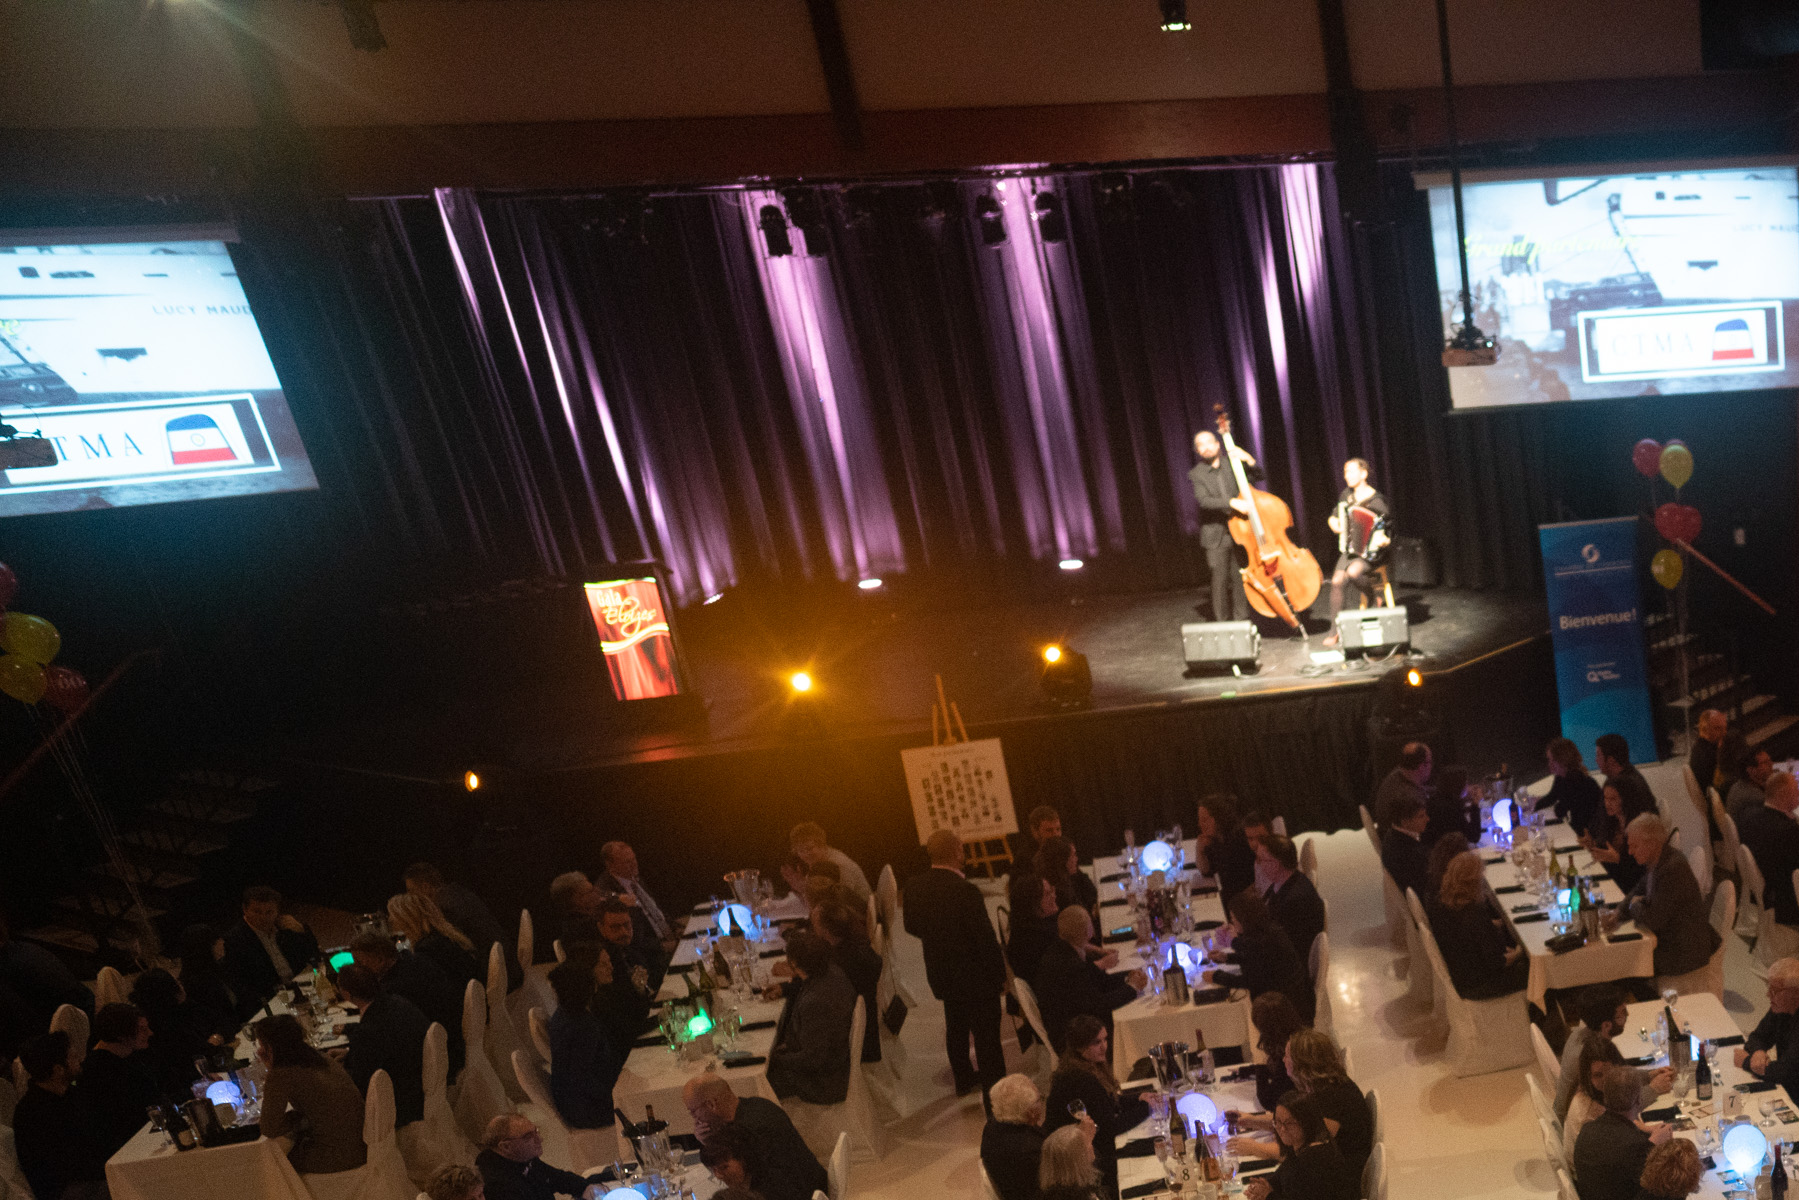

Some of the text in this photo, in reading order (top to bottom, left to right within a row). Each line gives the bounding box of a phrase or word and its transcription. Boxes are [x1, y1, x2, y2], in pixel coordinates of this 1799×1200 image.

[151, 304, 196, 316] LUCY
[1610, 331, 1695, 358] CTMA
[49, 431, 144, 462] TMA
[596, 589, 622, 608] Gala
[1558, 608, 1637, 631] Bienvenue!
[1728, 1095, 1736, 1108] 7
[1182, 1168, 1190, 1181] 8
